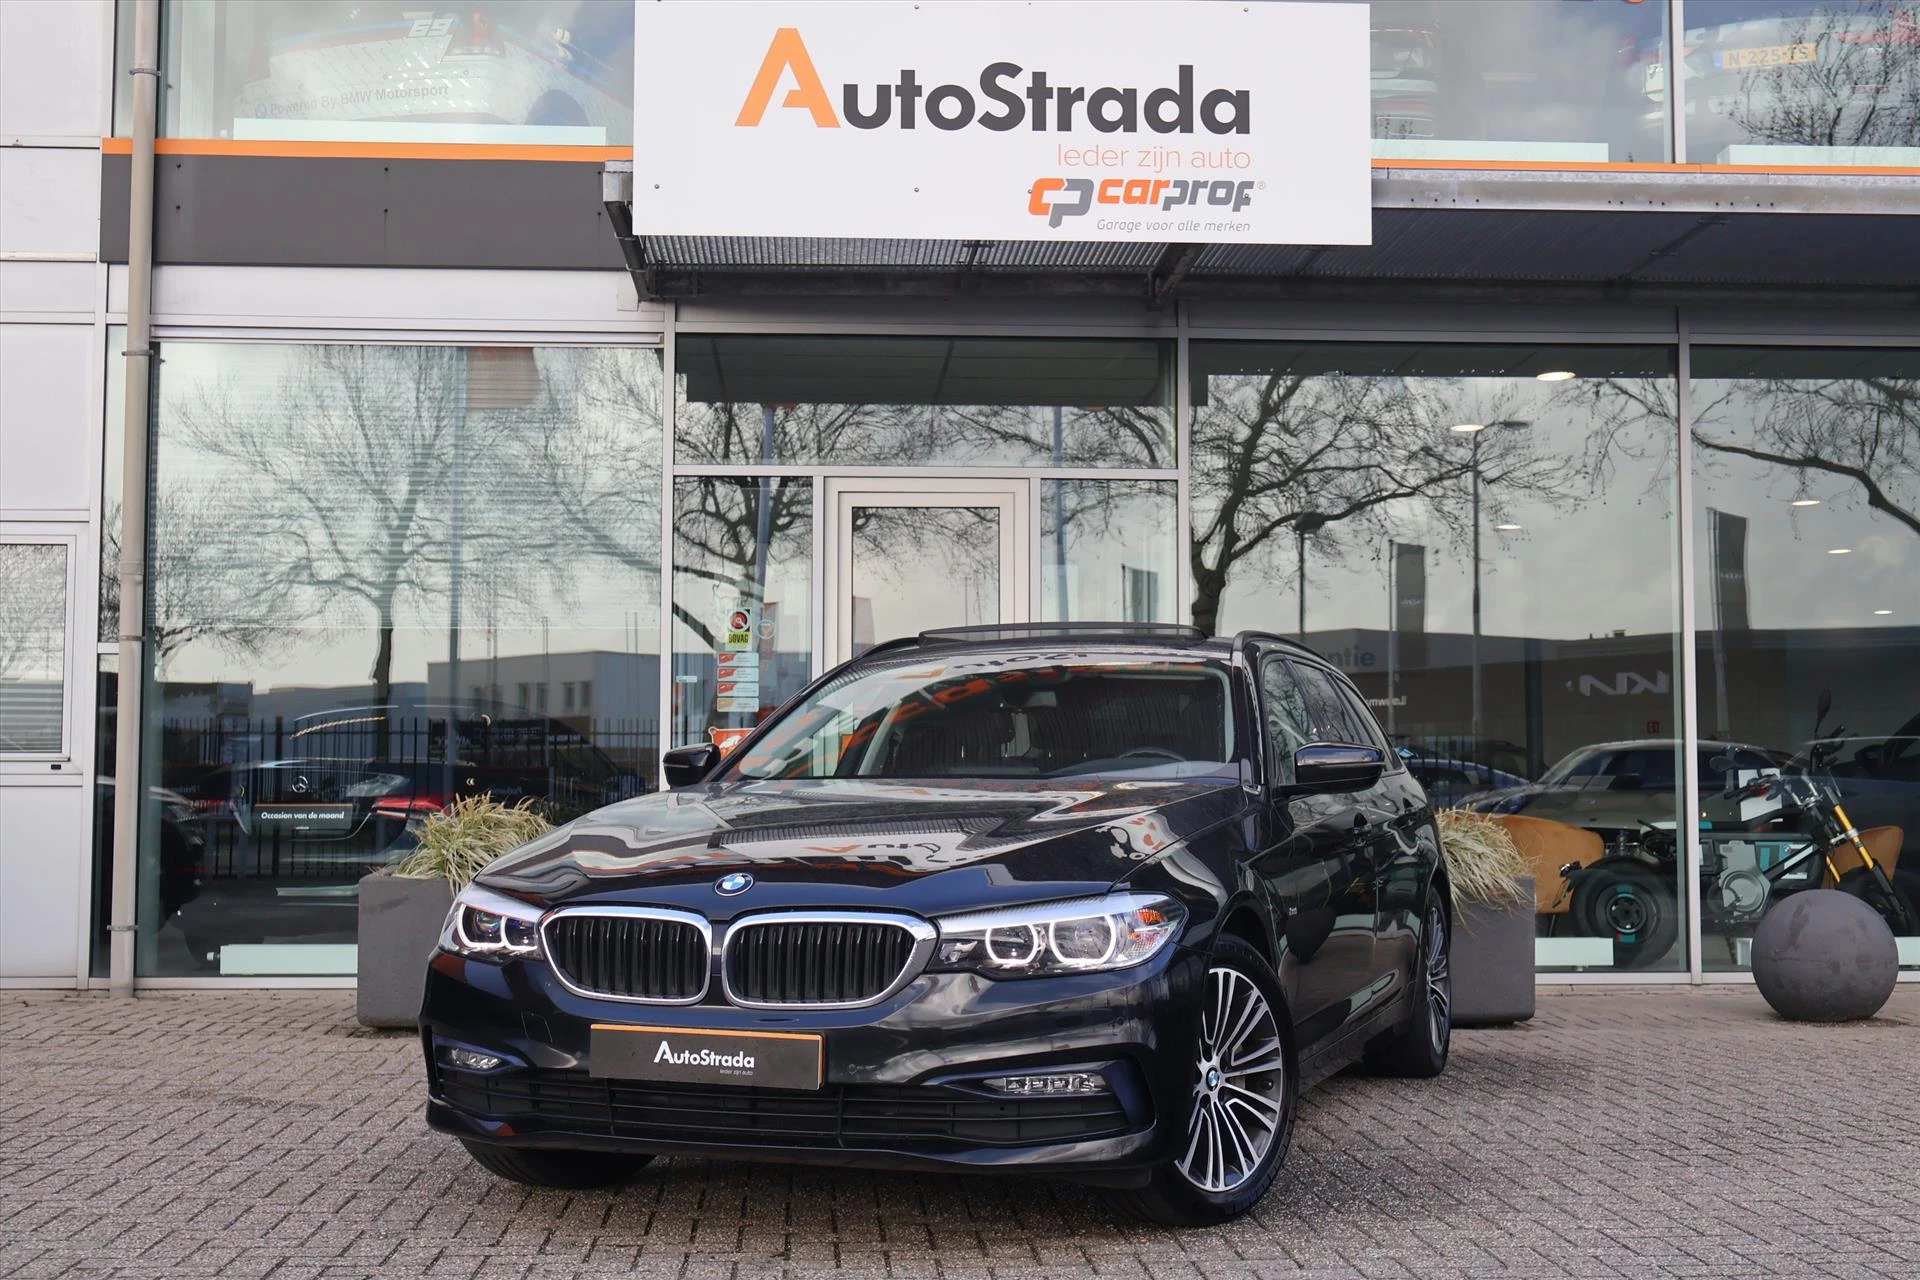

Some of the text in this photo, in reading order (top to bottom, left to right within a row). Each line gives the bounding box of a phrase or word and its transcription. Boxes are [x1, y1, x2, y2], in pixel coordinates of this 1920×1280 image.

[735, 28, 1250, 135] AutoStrada
[340, 88, 372, 106] BMW
[375, 84, 449, 102] Motorsport
[1058, 144, 1251, 173] Ieder zijn auto
[1097, 219, 1250, 233] Garage voor alle merken
[1321, 645, 1376, 667] ntie
[261, 811, 293, 819] Occasion
[308, 811, 318, 819] de
[318, 811, 345, 819] maand
[654, 1040, 755, 1068] AutoStrada
